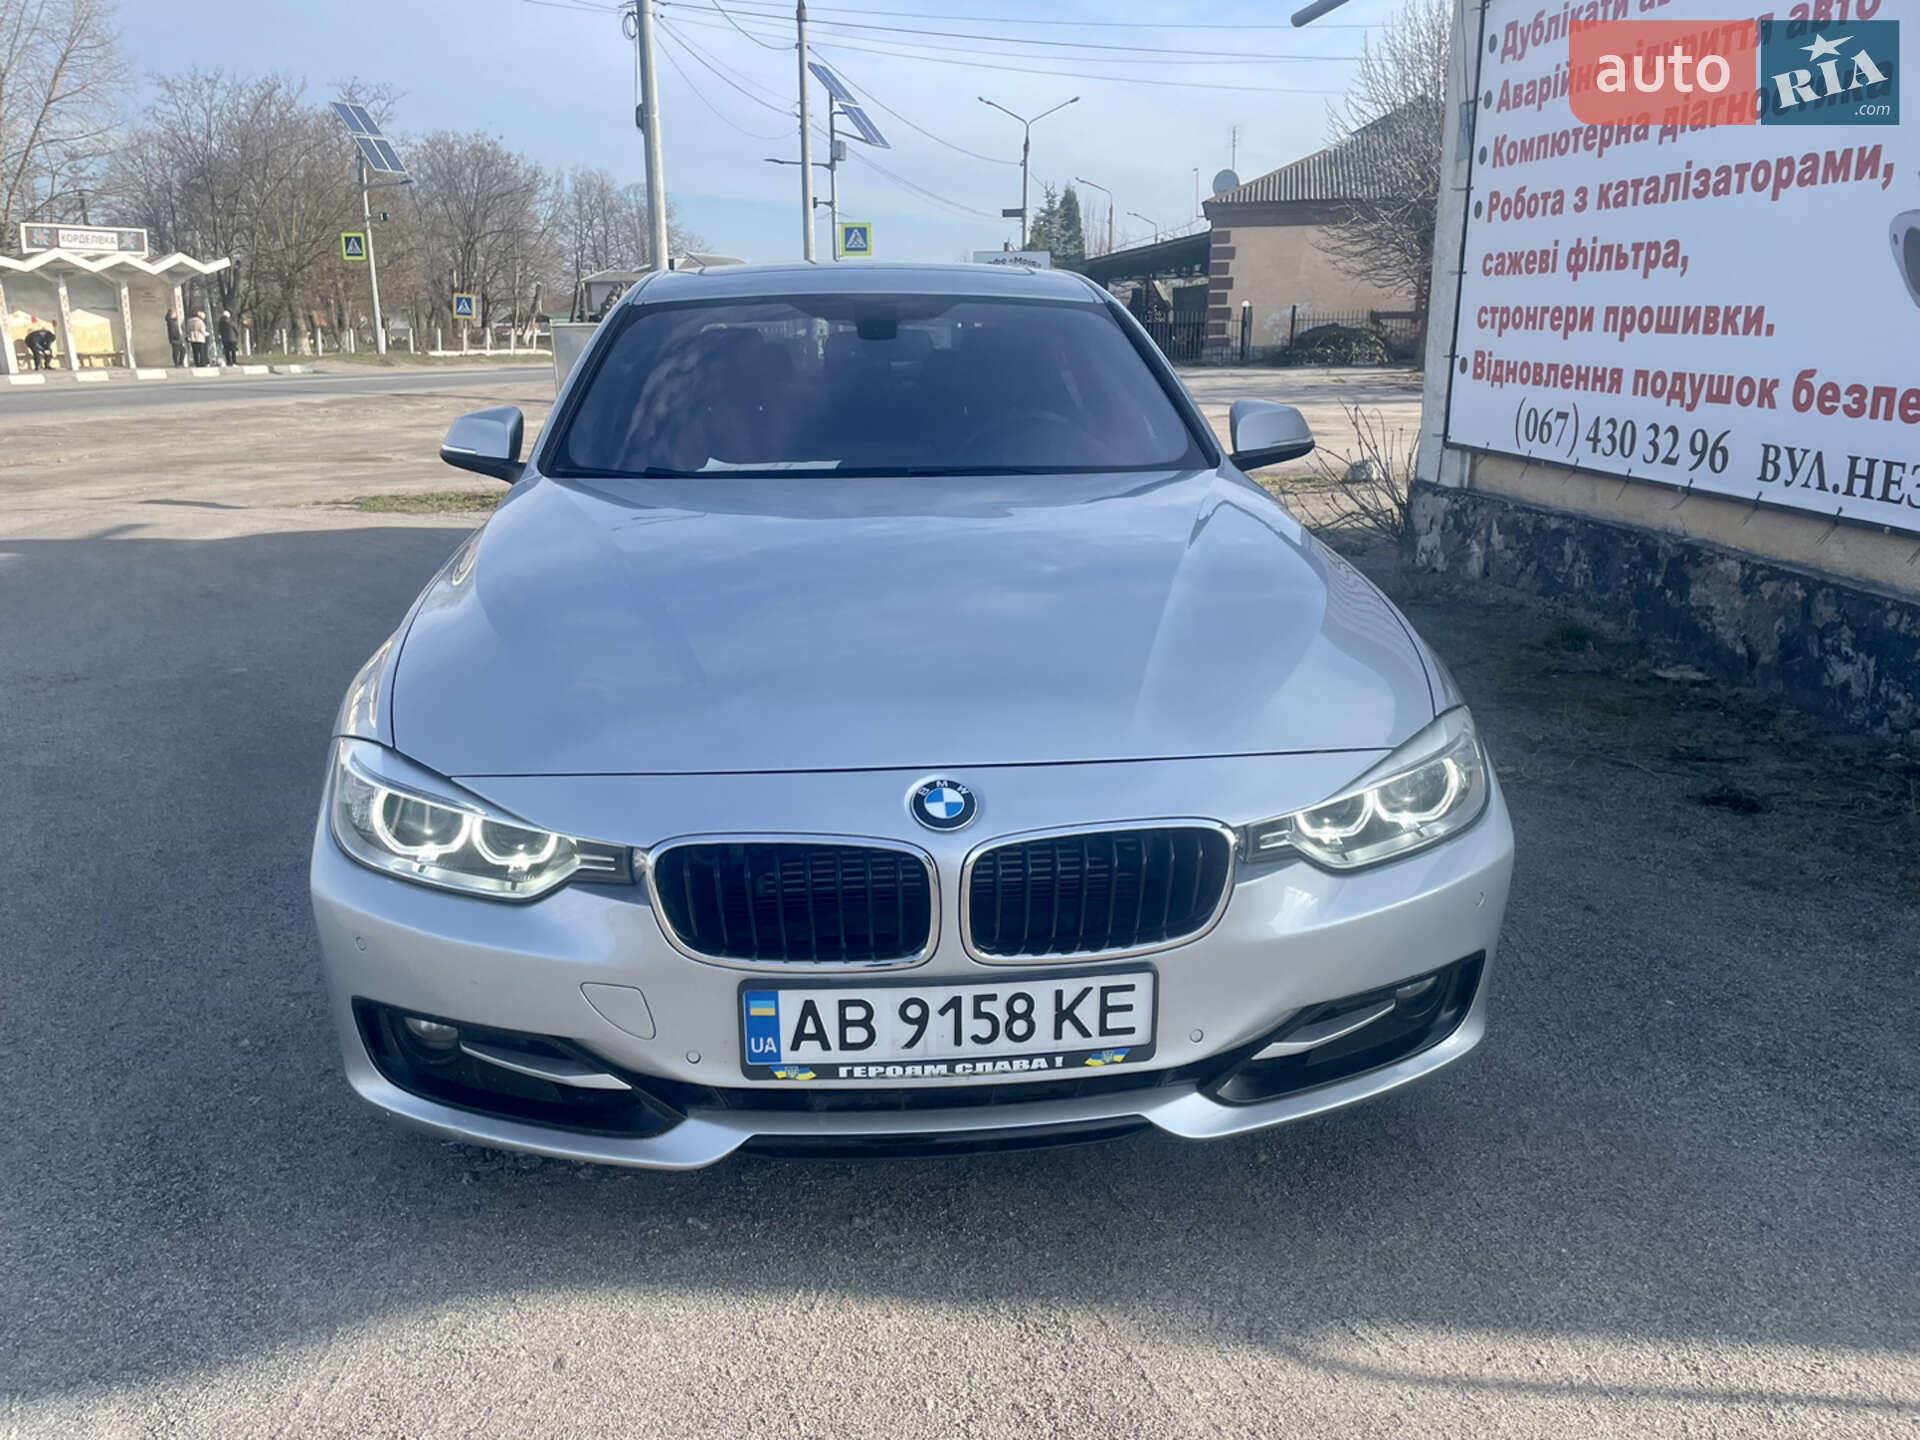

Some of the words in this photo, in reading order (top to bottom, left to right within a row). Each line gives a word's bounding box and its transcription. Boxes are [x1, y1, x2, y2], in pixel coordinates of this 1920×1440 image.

[1492, 111, 1648, 168] Компютерна
[1487, 185, 1564, 223] Робота
[1573, 186, 1588, 213] з
[1597, 144, 1895, 210] каталізаторами,
[1482, 240, 1558, 277] сажеві
[1566, 237, 1689, 281] фільтра,
[1477, 305, 1595, 340] стронгери
[1603, 305, 1775, 342] прошивки.
[1472, 350, 1624, 394] Відновлення
[1632, 368, 1780, 412] подушок
[1792, 368, 1920, 424] безпе
[1515, 397, 1579, 458] (067)
[918, 780, 969, 796] BMW
[789, 999, 876, 1051] AB
[899, 991, 1036, 1049] 9158
[1053, 984, 1136, 1041] KE
[751, 1038, 777, 1054] UA
[838, 1063, 947, 1078] ГЕРОЯМ
